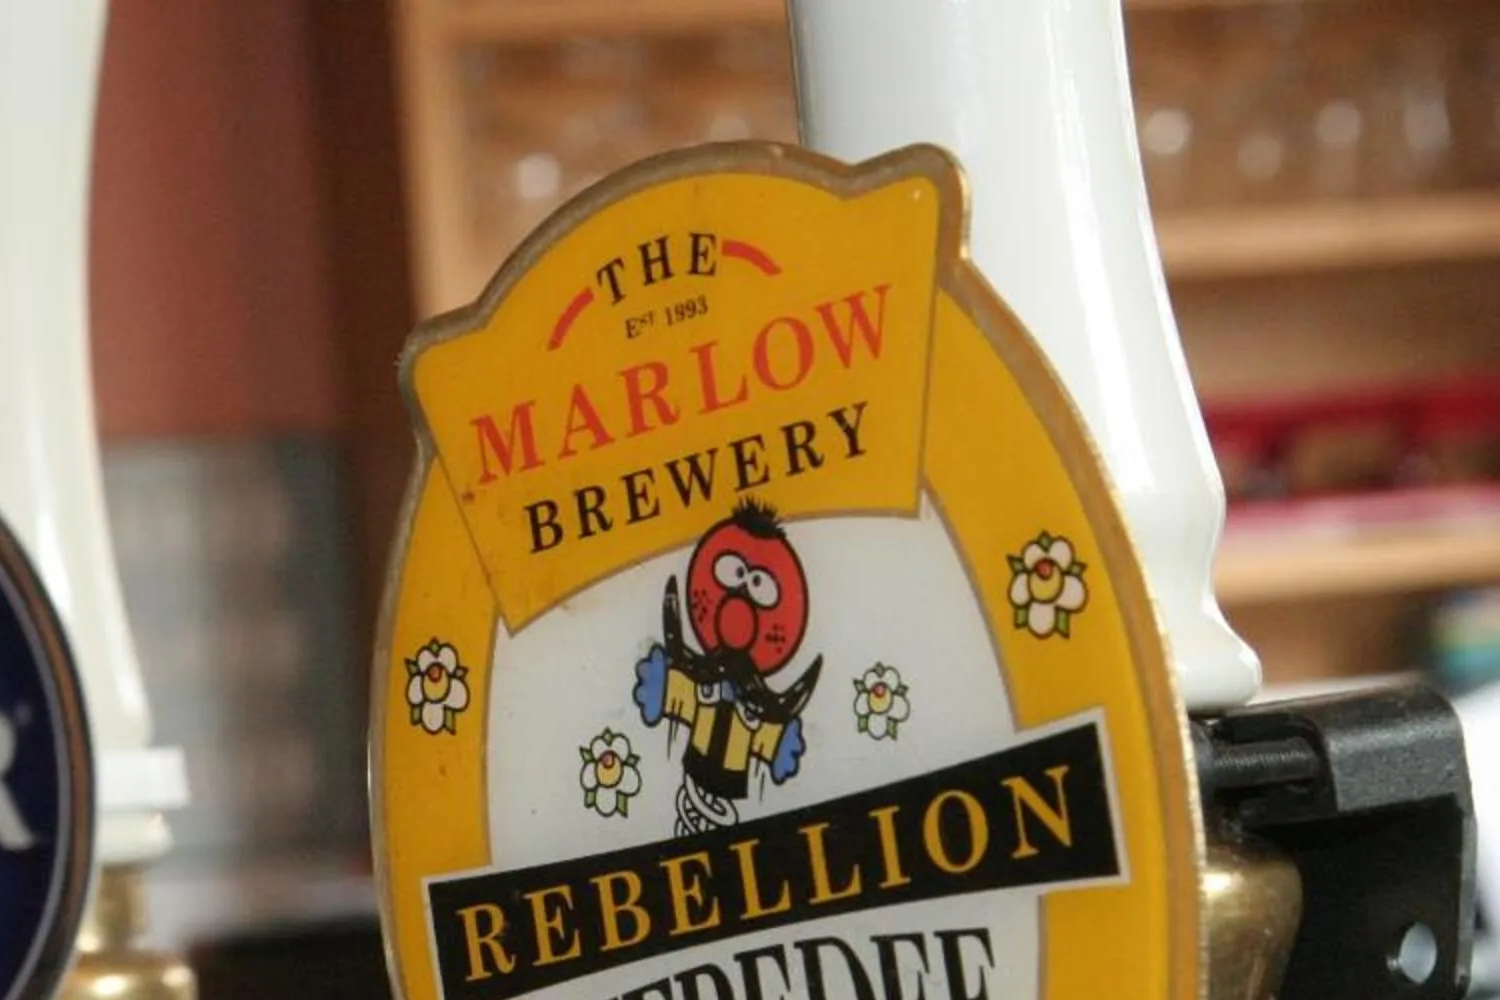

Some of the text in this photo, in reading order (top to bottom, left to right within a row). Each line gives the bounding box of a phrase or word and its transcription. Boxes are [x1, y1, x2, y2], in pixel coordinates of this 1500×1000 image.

[596, 231, 717, 305] THE
[469, 284, 893, 488] MARLOW
[523, 402, 870, 554] BREWERY
[456, 764, 1075, 982] REBELLION
